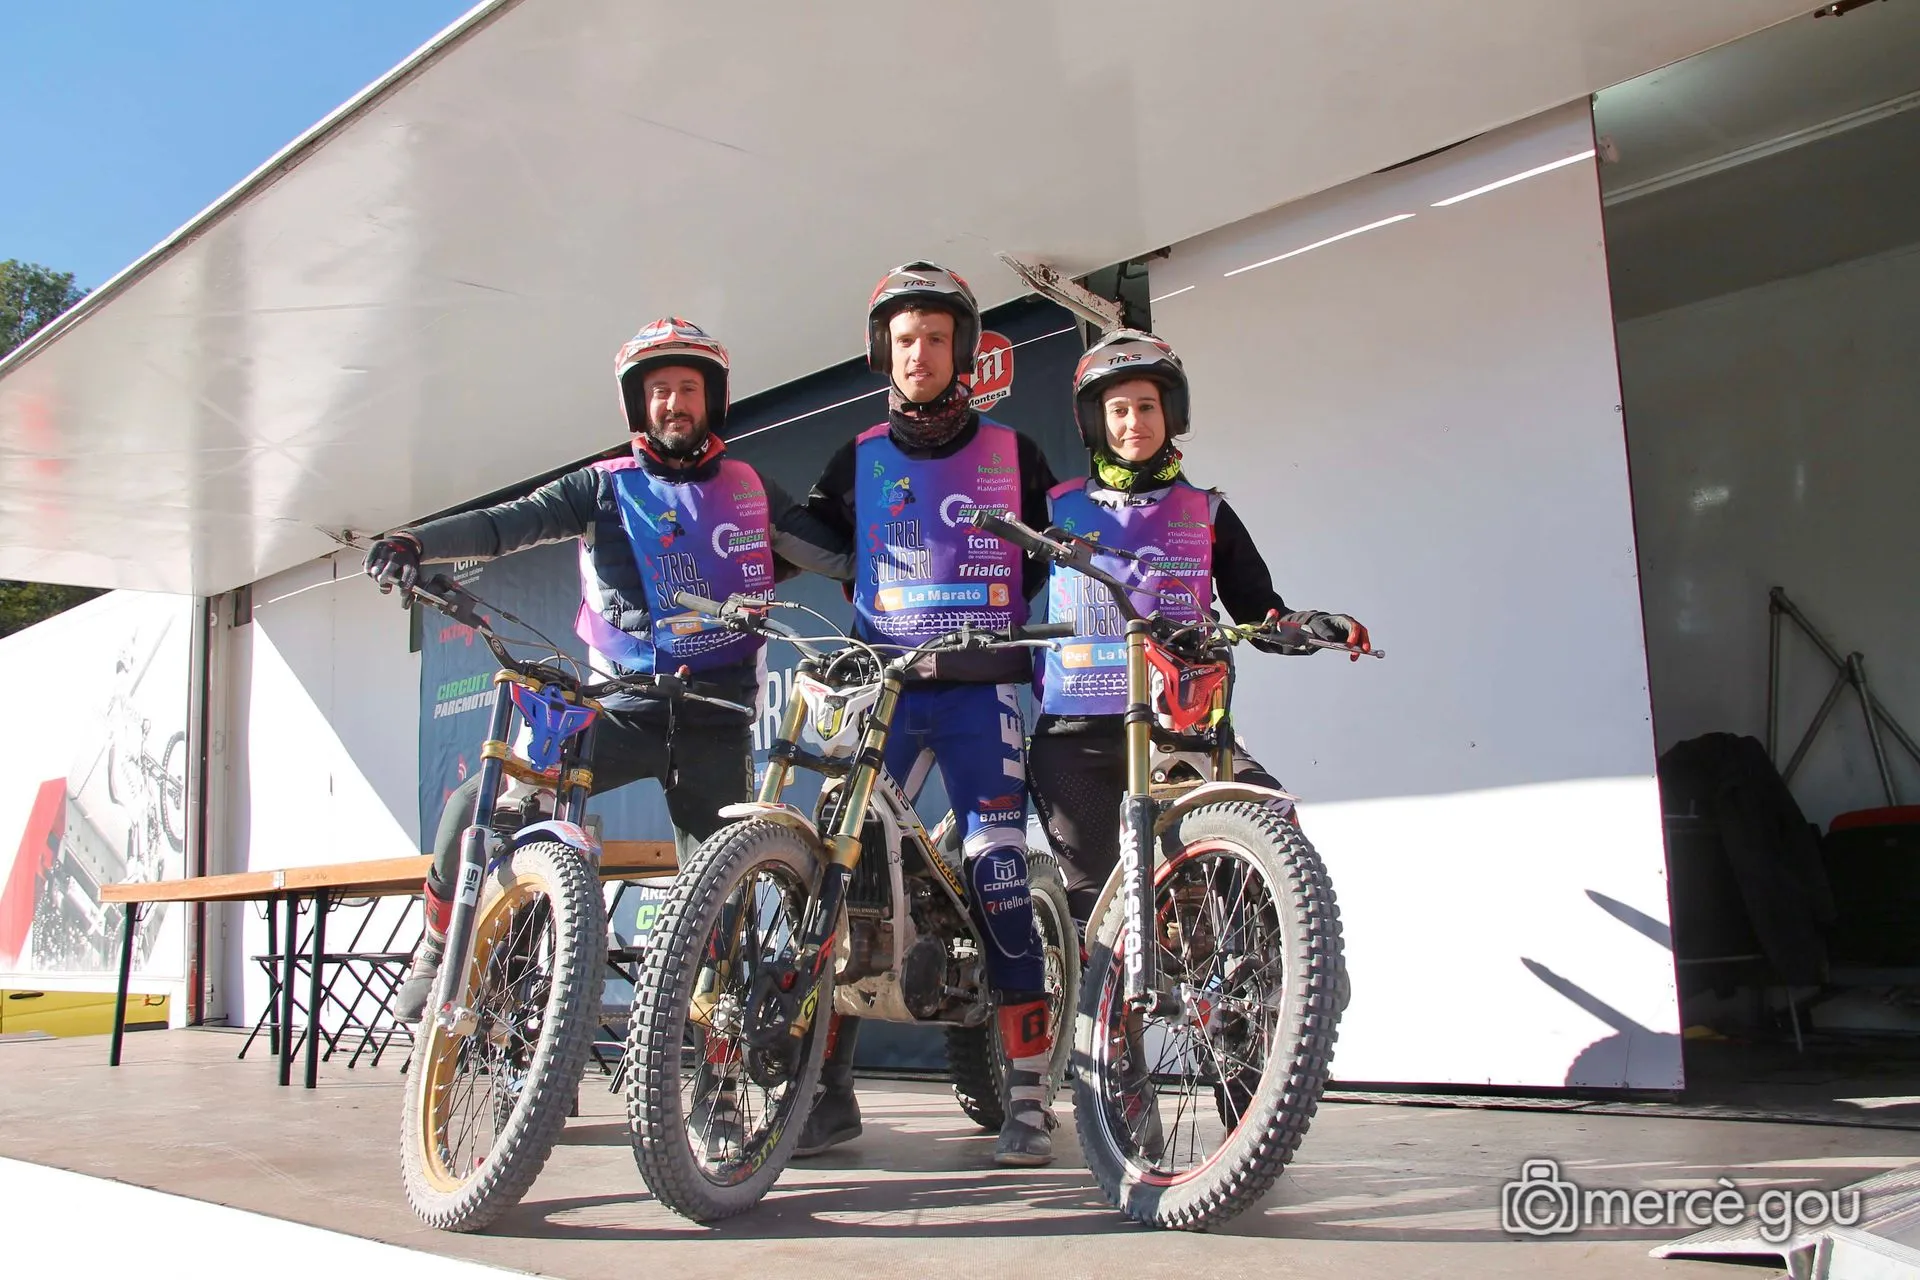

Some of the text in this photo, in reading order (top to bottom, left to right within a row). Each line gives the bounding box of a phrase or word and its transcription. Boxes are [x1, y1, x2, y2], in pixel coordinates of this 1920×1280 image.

[1108, 354, 1142, 365] TRS
[967, 535, 999, 549] fcm
[959, 564, 1011, 577] TrialGo
[908, 592, 925, 602] La
[928, 587, 981, 602] Marató
[1065, 651, 1089, 662] Per
[1097, 649, 1115, 661] La
[437, 672, 490, 700] CIRCUIT
[980, 810, 1021, 823] BAHCO
[1053, 827, 1074, 860] TEAM
[999, 895, 1023, 912] riello
